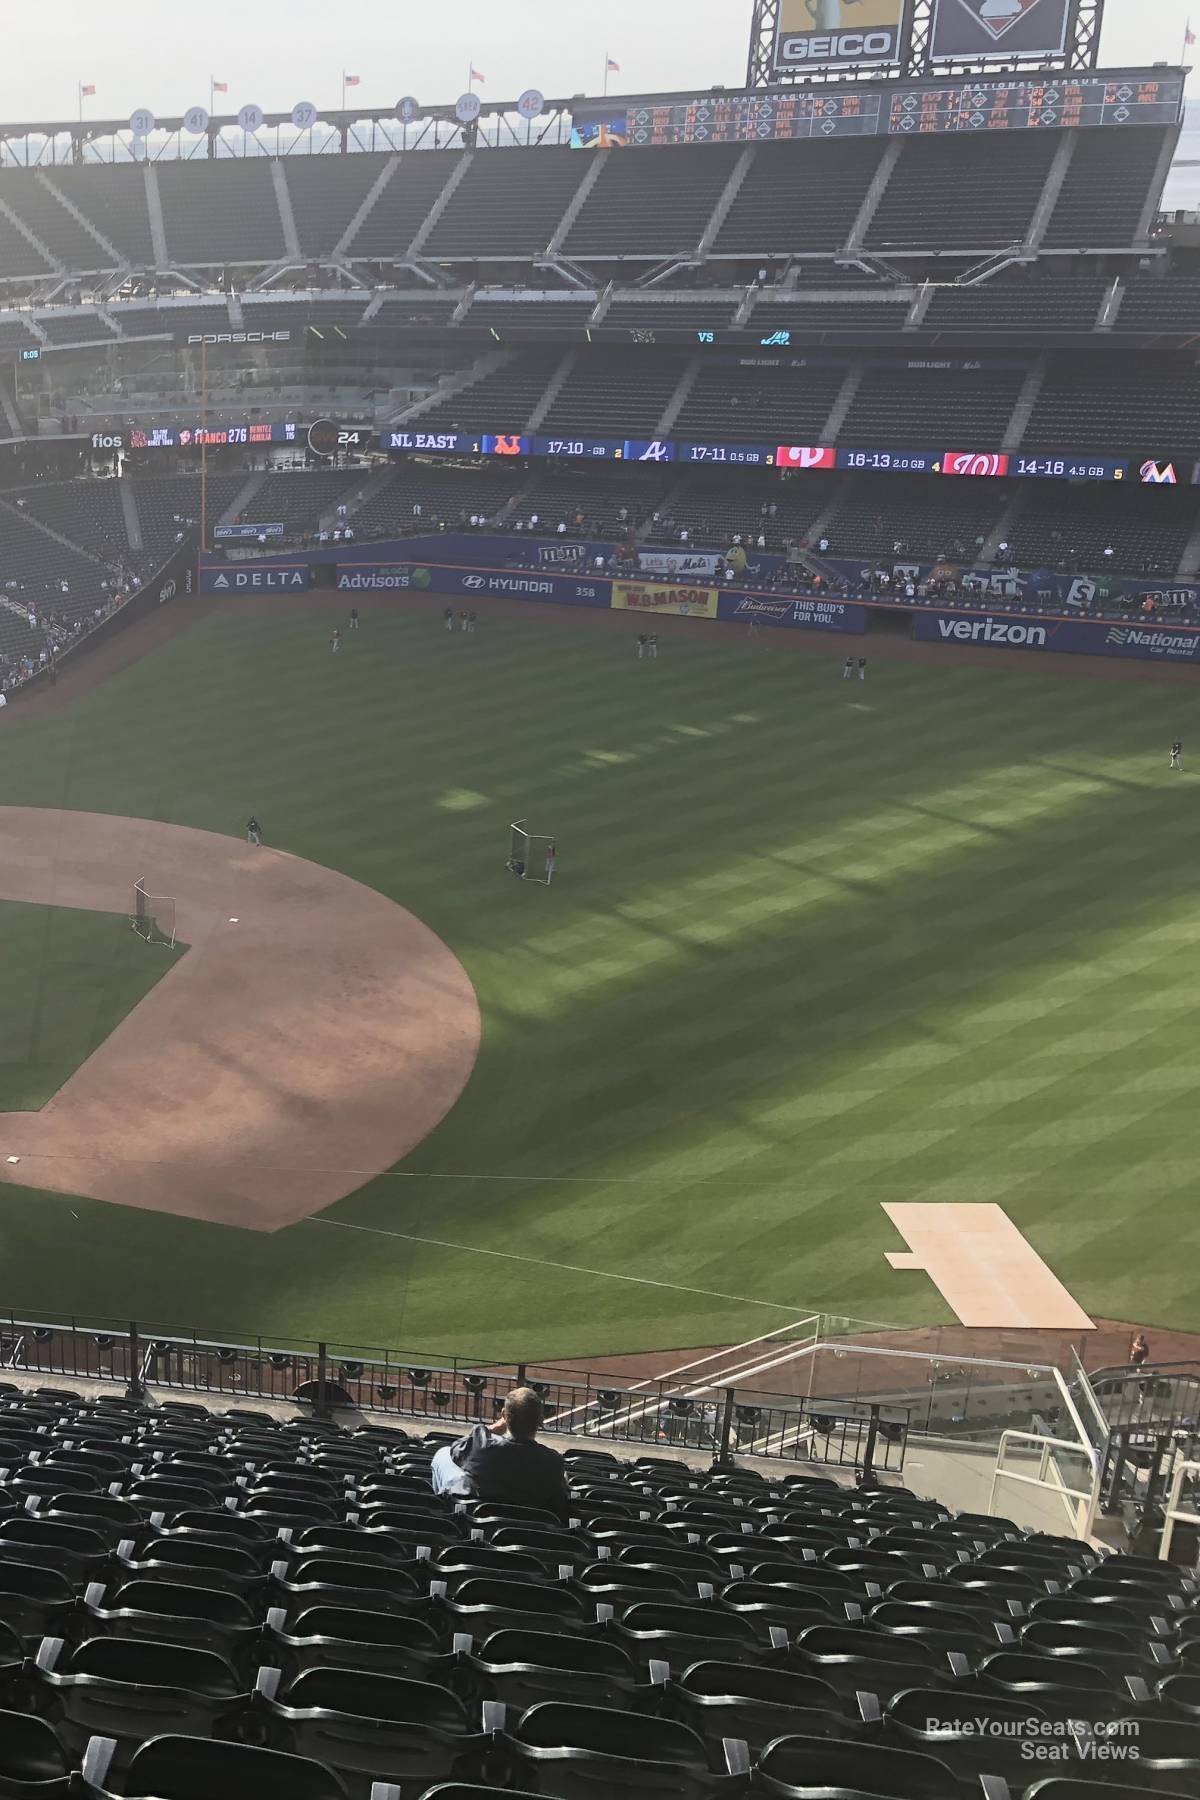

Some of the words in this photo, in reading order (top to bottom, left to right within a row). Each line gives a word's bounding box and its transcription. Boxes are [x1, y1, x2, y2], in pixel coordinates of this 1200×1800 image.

[783, 32, 891, 60] GEICO
[963, 81, 1034, 91] NATIONAL
[1043, 78, 1099, 88] LEAGUE
[522, 97, 538, 111] 42
[692, 96, 757, 106] AMERICAN
[764, 93, 814, 101] LEAGUE
[190, 114, 203, 127] 41
[244, 112, 256, 124] 14
[297, 109, 311, 122] 37
[136, 117, 148, 129] 31
[188, 331, 290, 344] PORSCHE
[698, 332, 714, 342] VS
[92, 433, 122, 448] fios
[228, 428, 247, 443] 276
[338, 432, 360, 444] 24
[390, 434, 413, 447] NL
[416, 435, 457, 449] EAST
[473, 443, 479, 452] 1
[548, 441, 583, 455] 17-10
[615, 448, 622, 458] 2
[691, 447, 726, 461] 17-11
[730, 452, 744, 461] 0.5
[746, 453, 759, 462] GB
[766, 455, 773, 464] 3
[893, 459, 908, 468] 2.0
[910, 459, 925, 469] GB
[931, 462, 940, 472] 4
[1017, 460, 1064, 475] 14-16
[1069, 466, 1086, 476] 4.5
[1088, 467, 1104, 476] GB
[1113, 469, 1123, 479] 5
[236, 571, 303, 587] DELTA
[338, 574, 409, 589] Advisors
[489, 578, 553, 593] HYUNDAI
[575, 587, 595, 598] 358
[741, 600, 787, 613] Budweiser
[794, 601, 815, 611] THIS
[817, 603, 844, 614] BUD'S
[793, 611, 811, 622] FOR
[813, 613, 834, 624] YOU.
[938, 618, 1046, 645] verizon
[1126, 630, 1199, 649] National
